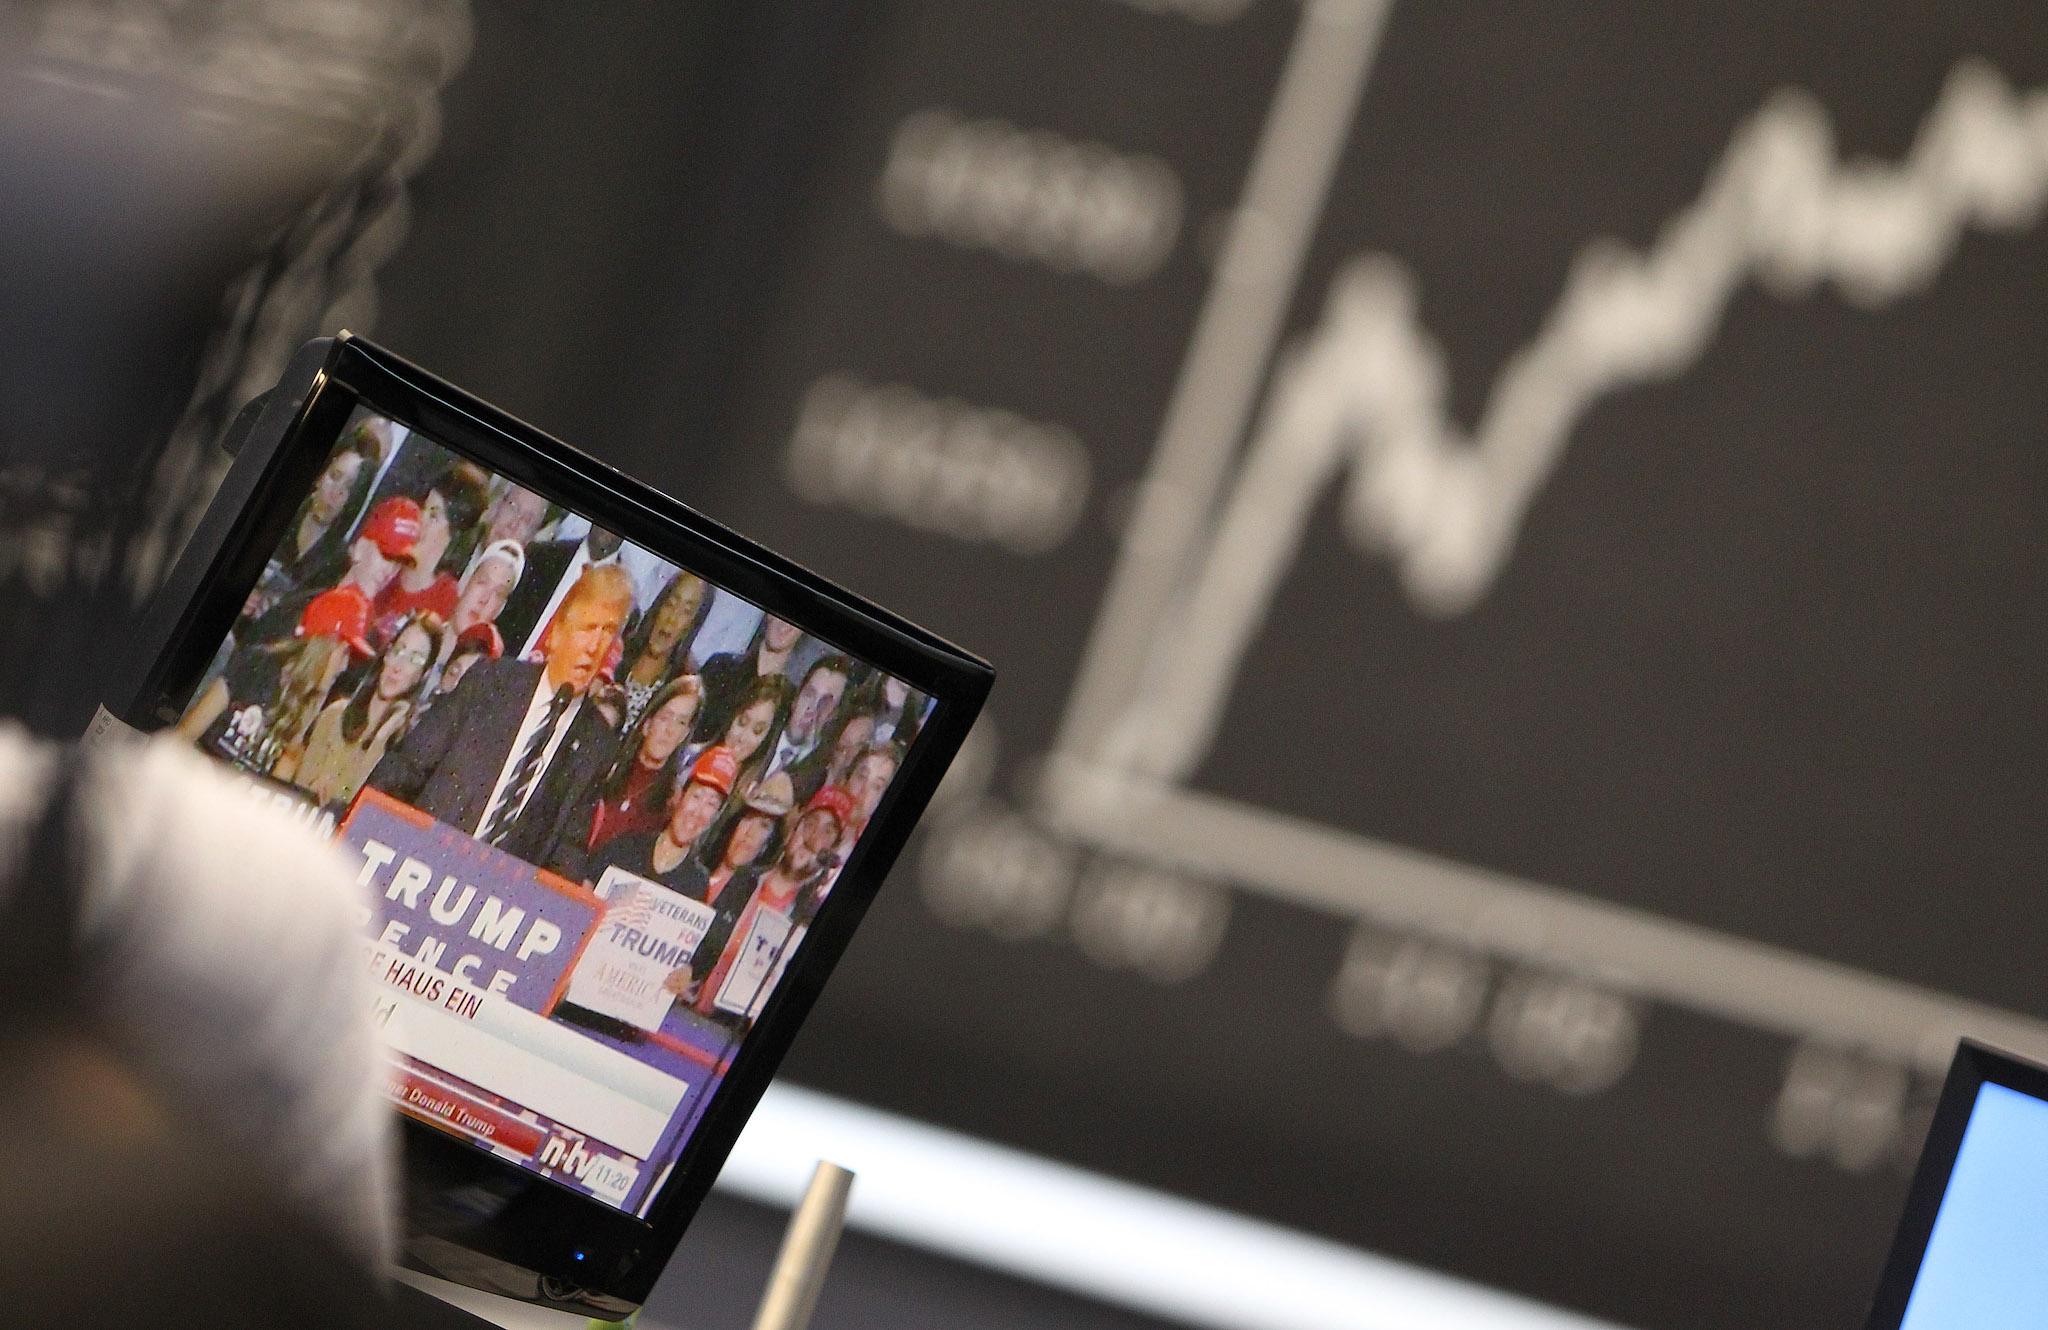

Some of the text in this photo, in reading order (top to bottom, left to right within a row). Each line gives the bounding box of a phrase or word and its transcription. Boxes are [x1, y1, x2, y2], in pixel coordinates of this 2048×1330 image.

[356, 839, 562, 961] TRUMP
[609, 922, 692, 968] TRUMP
[384, 959, 445, 1002] HAUS
[444, 986, 483, 1020] EIN
[408, 1087, 457, 1119] Donald
[454, 1107, 497, 1137] Trump
[596, 1164, 630, 1191] 11:20
